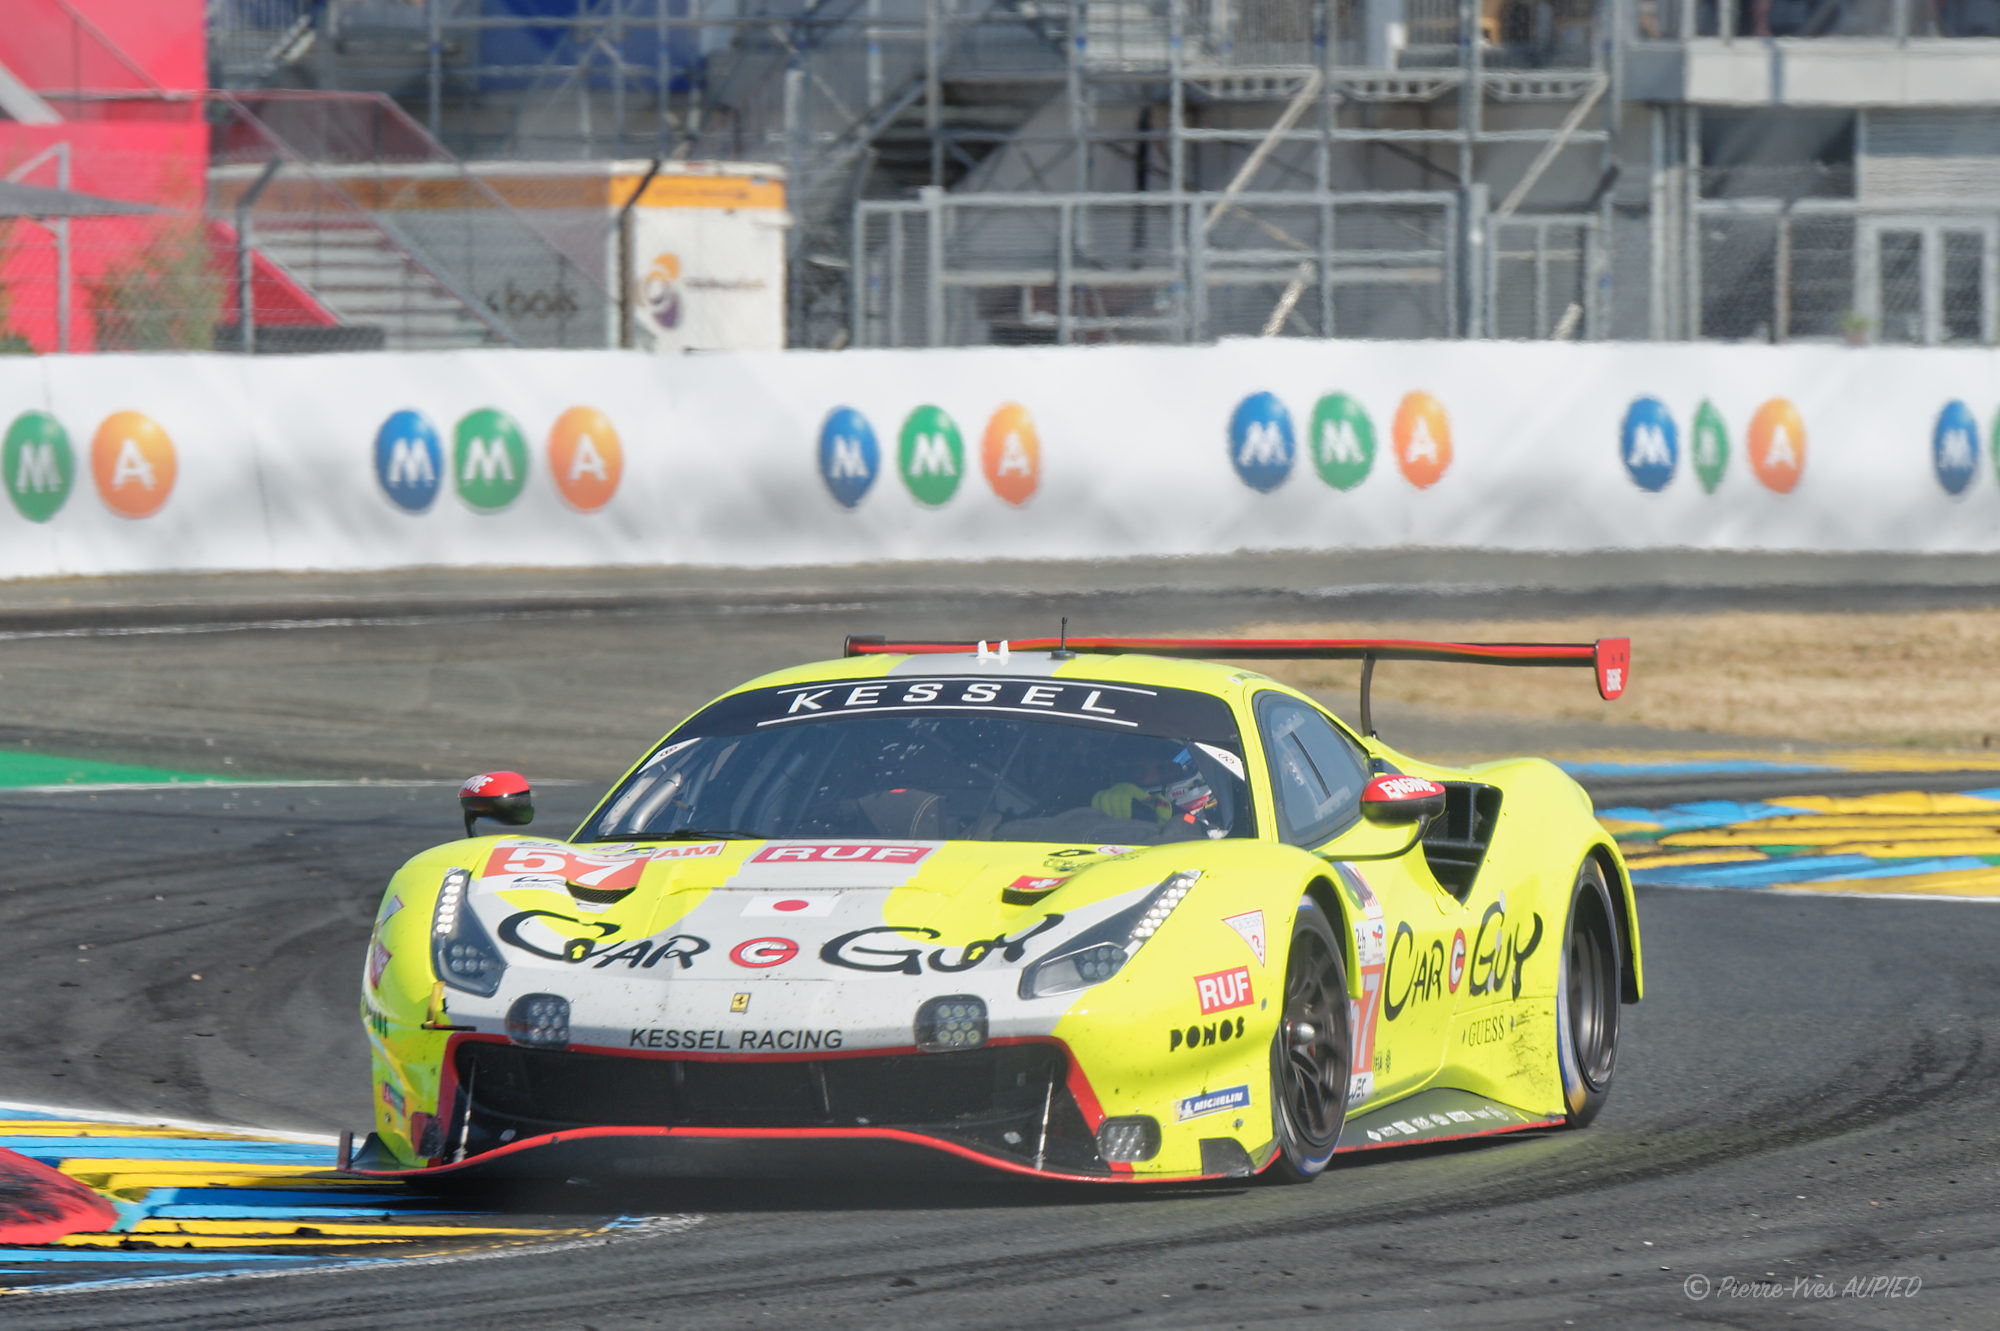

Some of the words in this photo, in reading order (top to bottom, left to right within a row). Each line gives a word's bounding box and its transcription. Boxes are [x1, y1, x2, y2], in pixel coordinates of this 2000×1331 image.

[787, 683, 1117, 715] KESSEL
[503, 848, 636, 887] 57
[657, 844, 721, 860] AM
[765, 847, 919, 861] RUF
[497, 909, 711, 970] CAR
[820, 914, 1065, 976] GUY
[1384, 920, 1444, 1022] CAR
[1469, 902, 1543, 1001] GUY
[1198, 971, 1249, 1010] RUF
[630, 1028, 731, 1049] KESSEL
[739, 1030, 844, 1050] RACING
[1169, 1016, 1245, 1052] PONOS
[1467, 1014, 1505, 1048] GUESS
[1193, 1091, 1244, 1112] MICHELIN
